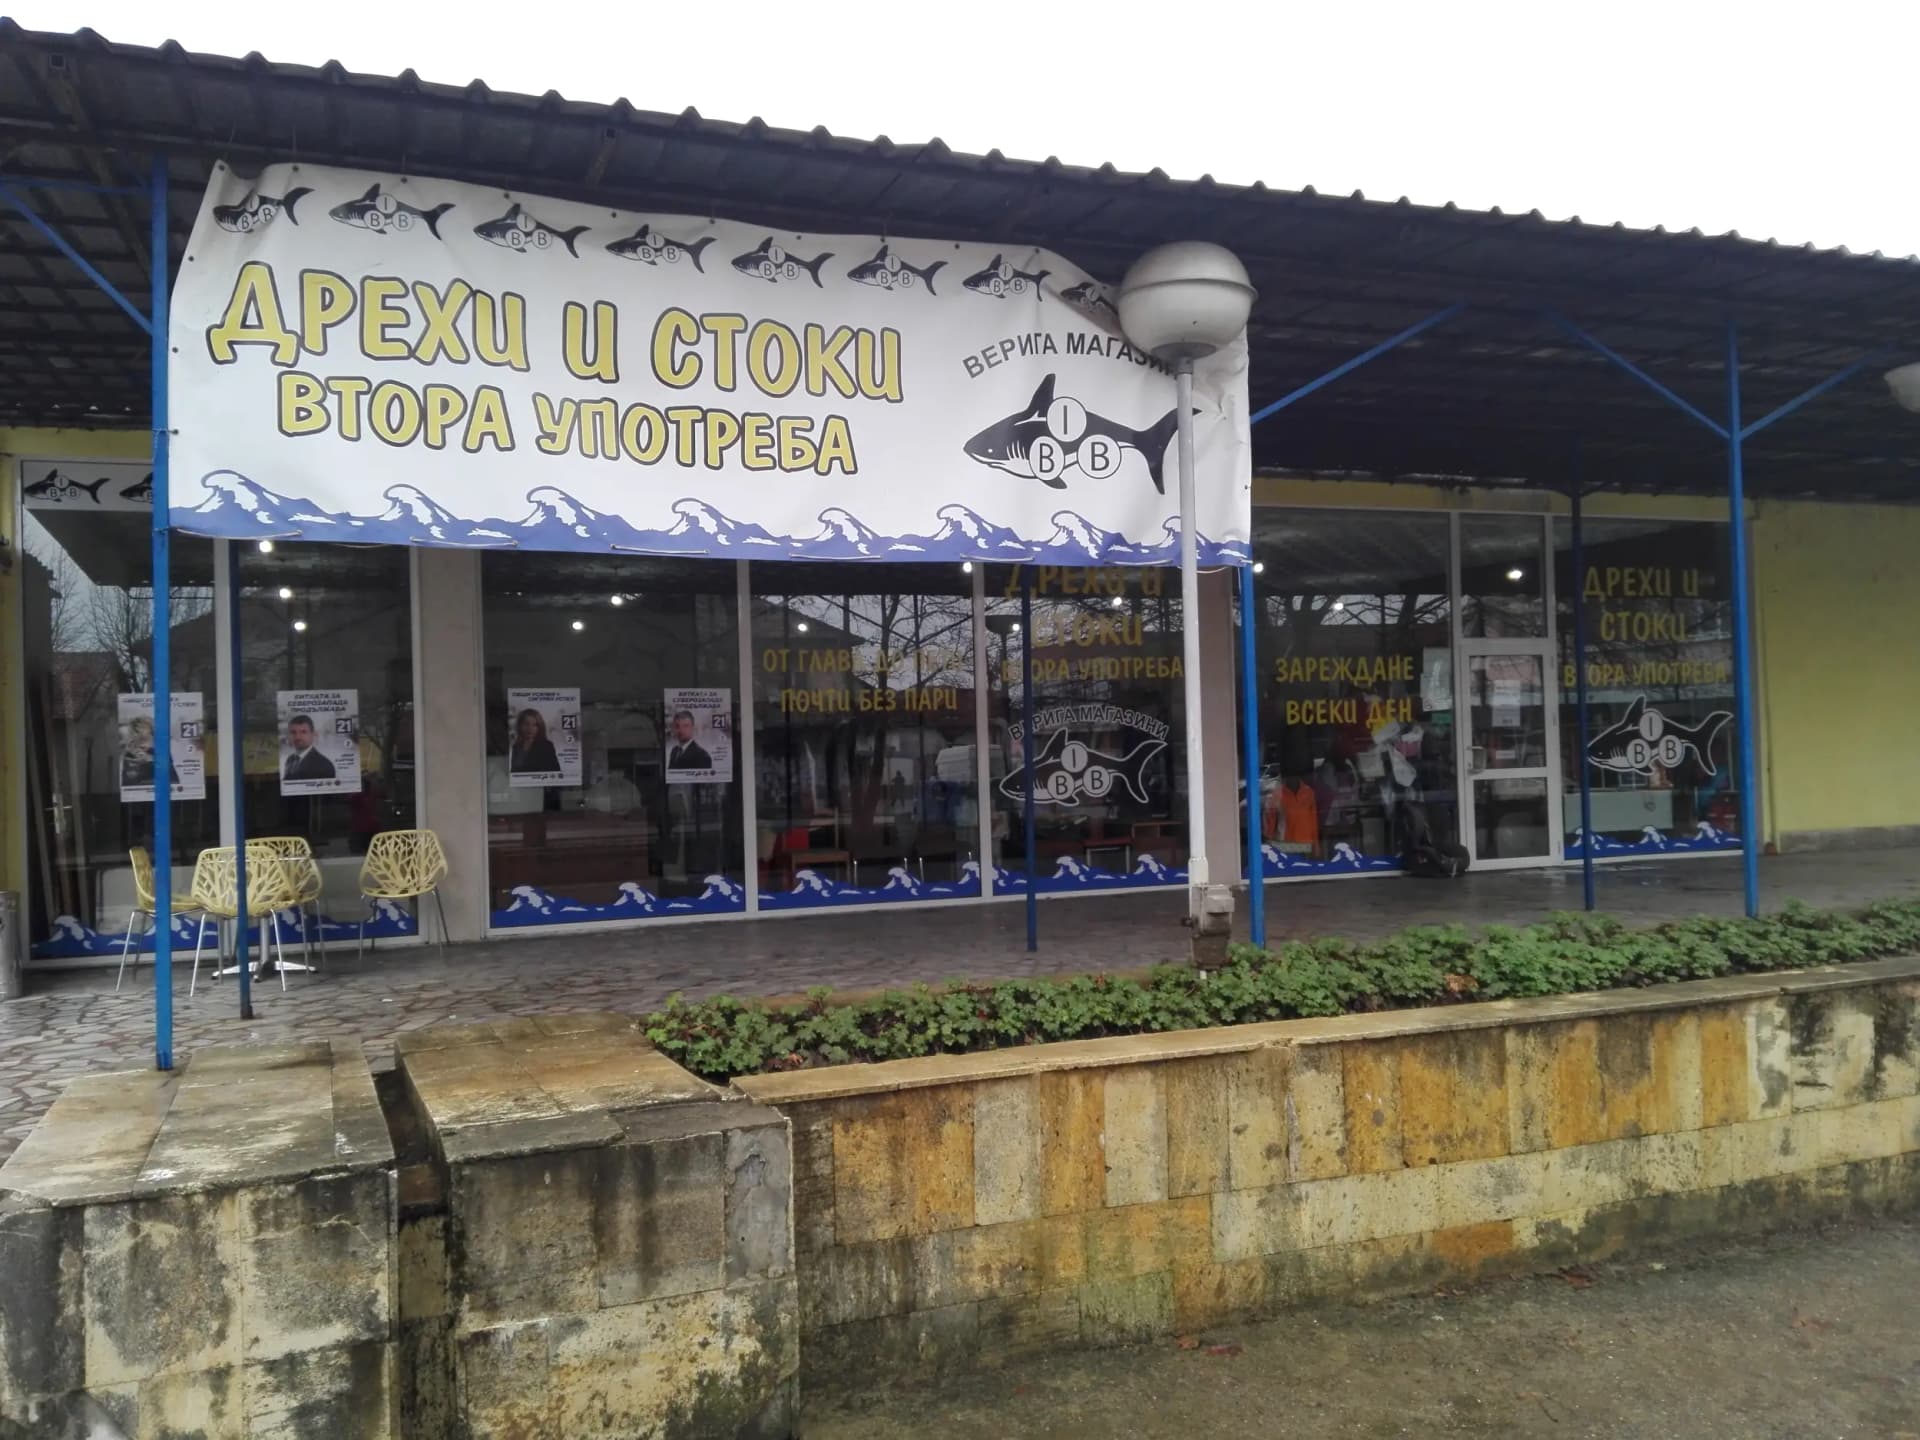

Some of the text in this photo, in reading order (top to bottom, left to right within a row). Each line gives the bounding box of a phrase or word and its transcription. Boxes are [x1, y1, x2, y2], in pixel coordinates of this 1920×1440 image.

[206, 261, 903, 402] ДРЕХИ И СТОКИ
[962, 332, 1058, 379] ВЕРИГА
[276, 371, 858, 475] ВТОРА УПОТРЕБА
[1039, 441, 1110, 473] B B
[1583, 566, 1672, 602] ДРЕХИ
[1031, 612, 1143, 647] СТОКИ
[1601, 610, 1687, 641] СТОКИ
[763, 649, 789, 672] ОТ
[1001, 655, 1184, 684] ВОРА УПОТРЕБА
[1275, 656, 1414, 687] ЗАРЕЖДАНЕ
[1563, 660, 1727, 688] ВОРА УПОТРЕБА
[781, 687, 957, 713] ПОЧТИ БЕЗ ПАРИ
[1286, 700, 1412, 729] ВСЕКИ ДЕН
[182, 723, 198, 737] 21
[336, 720, 352, 733] 21
[563, 717, 576, 729] 21
[714, 716, 726, 728] 21
[1008, 704, 1170, 741] ВРИГА МАГАЗИНИ
